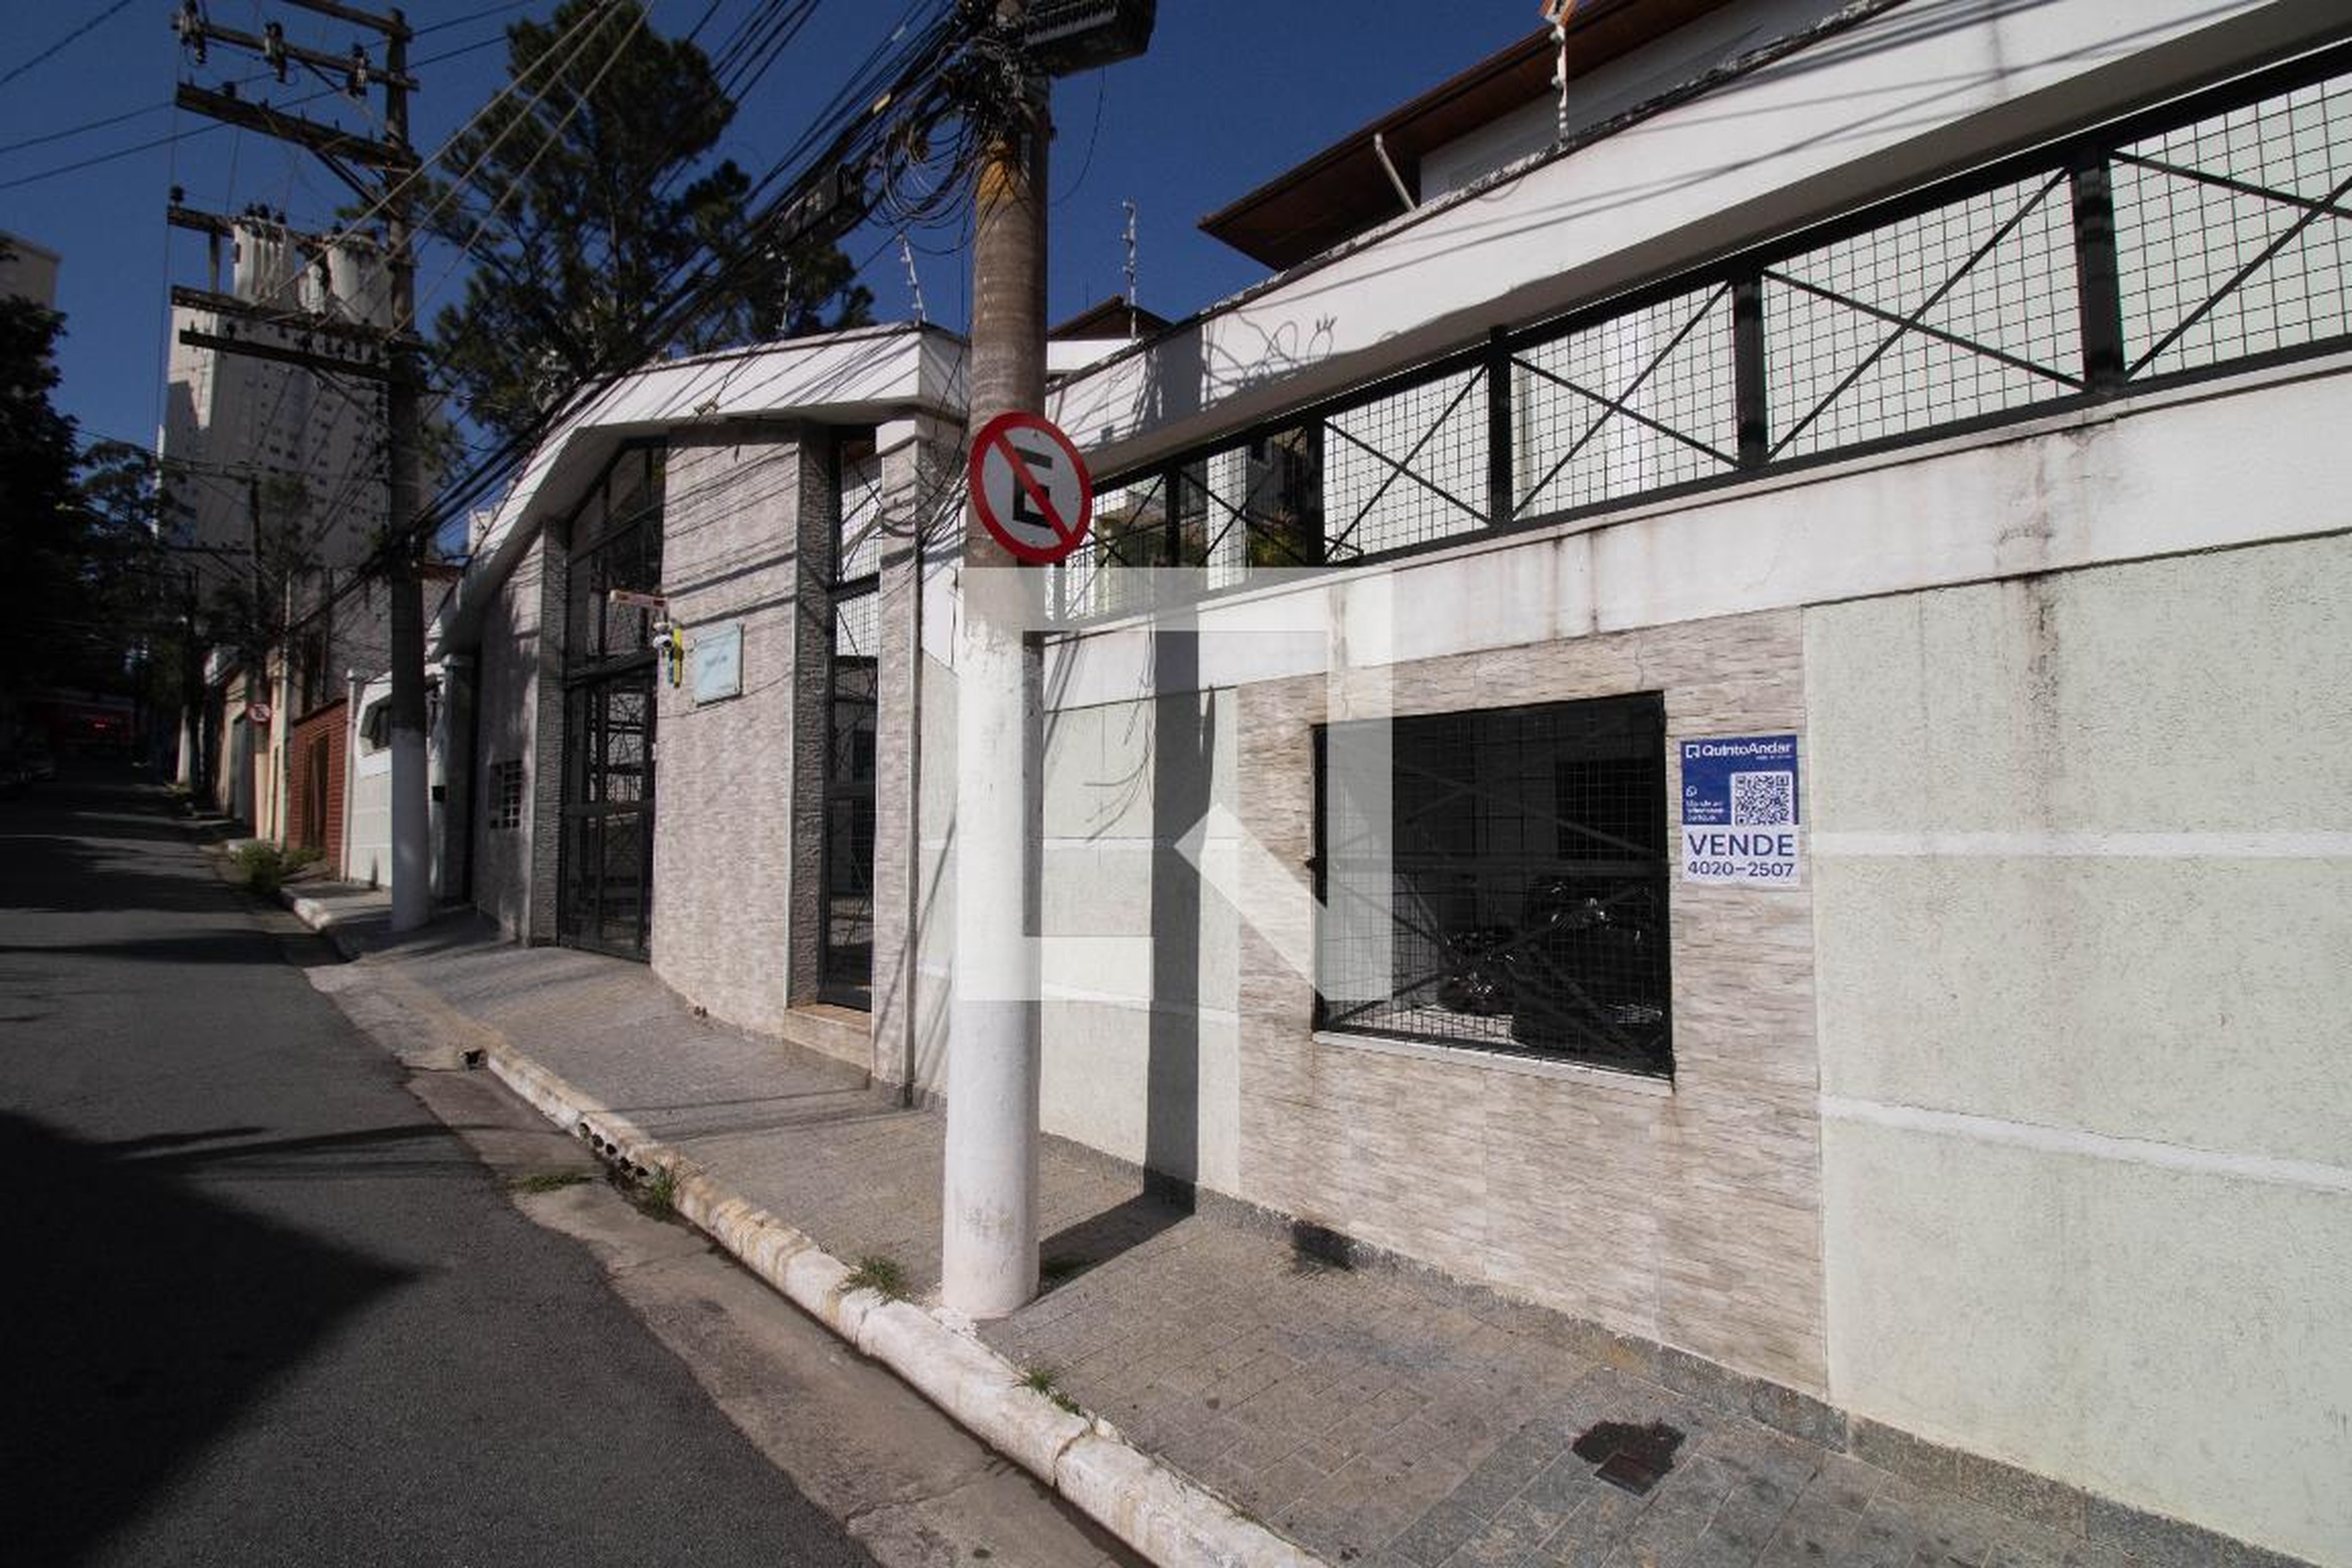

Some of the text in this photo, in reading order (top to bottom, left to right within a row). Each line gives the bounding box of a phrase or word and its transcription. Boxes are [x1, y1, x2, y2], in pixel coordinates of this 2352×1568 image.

[1702, 742, 1791, 756] QuintoAndar
[1689, 834, 1795, 856] VENDE
[1688, 861, 1795, 876] 4020-2507
